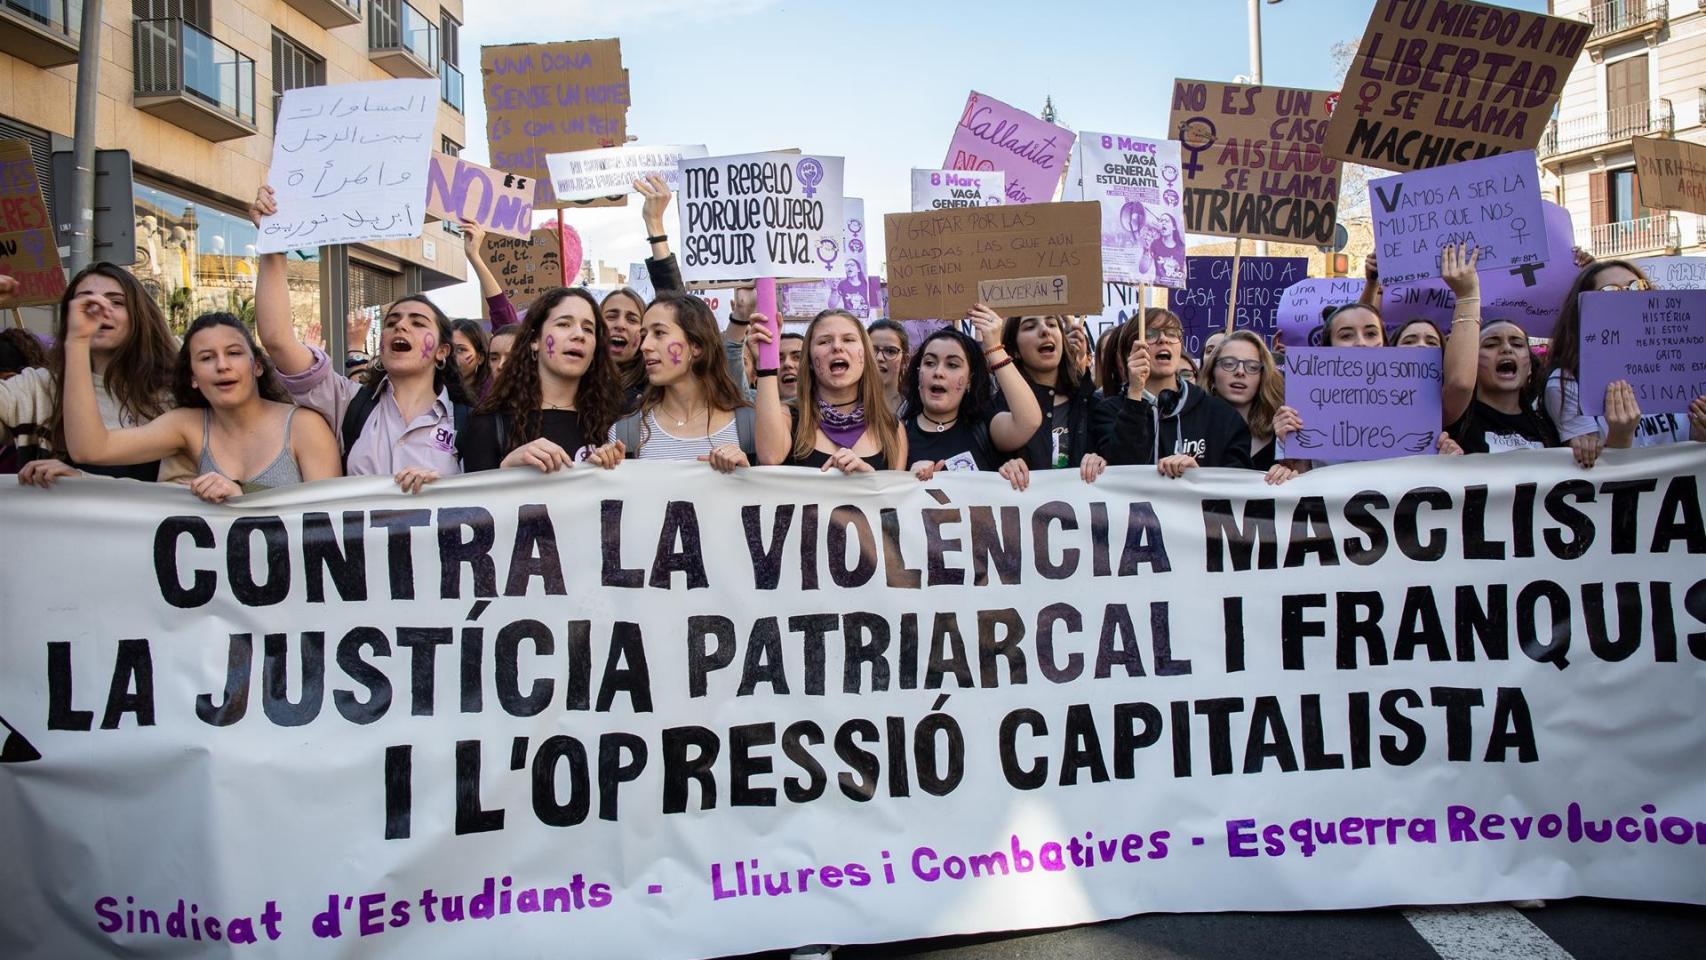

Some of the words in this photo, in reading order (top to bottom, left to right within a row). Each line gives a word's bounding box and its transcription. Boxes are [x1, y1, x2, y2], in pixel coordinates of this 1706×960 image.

[1426, 2, 1520, 46] MIEDO
[1517, 16, 1547, 50] A
[1546, 21, 1595, 59] MI
[1360, 33, 1558, 109] LIBERTAD
[1173, 83, 1207, 112] NO
[1221, 86, 1262, 115] ES
[1275, 89, 1313, 117] UN
[1383, 90, 1425, 121] SE
[1434, 97, 1529, 140] LLAMA
[1269, 117, 1329, 145] CASO
[1101, 135, 1113, 150] 8
[1117, 136, 1157, 156] Març
[1217, 138, 1337, 175] AISLADO
[1345, 118, 1512, 170] MACHISM
[1104, 163, 1158, 179] GENERAL
[1123, 154, 1158, 167] VAGA
[426, 157, 494, 225] NO
[930, 172, 941, 186] 8
[945, 173, 982, 188] Març
[1096, 174, 1159, 189] ESTUDIANTIL
[1221, 168, 1251, 191] SE
[1259, 171, 1338, 201] LLAMA
[1450, 185, 1461, 202] A
[1468, 179, 1496, 200] SER
[1503, 174, 1525, 193] LA
[932, 199, 981, 209] GENERAL
[950, 189, 982, 200] VAGA
[490, 194, 533, 236] NO
[890, 217, 903, 242] Y
[908, 213, 962, 241] GRITAR
[967, 213, 999, 232] POR
[1002, 210, 1036, 229] LAS
[1183, 187, 1337, 243] ATRIARCADO
[1378, 210, 1438, 237] MUJER
[1444, 207, 1473, 226] QUE
[1480, 202, 1514, 223] NOS
[1010, 237, 1041, 251] QUE
[1384, 243, 1403, 258] DE
[1413, 238, 1428, 254] LA
[893, 264, 913, 280] NO
[918, 261, 963, 278] TIENEN
[979, 256, 1018, 273] ALAS
[1036, 250, 1047, 269] Y
[1049, 250, 1081, 268] LAS
[1279, 265, 1297, 282] A
[891, 284, 919, 299] QUE
[924, 282, 942, 297] YA
[946, 280, 965, 296] NO
[981, 282, 1049, 303] VOLVERÁN
[1174, 287, 1217, 307] CASA
[1391, 287, 1420, 304] SIN
[1425, 287, 1457, 309] MIE
[1648, 297, 1661, 309] NI
[1665, 297, 1683, 309] SOY
[1636, 336, 1705, 347] MENSTRUANDO
[1644, 327, 1657, 335] NI
[1662, 325, 1690, 335] ESTOY
[1656, 350, 1682, 361] GRITO
[1287, 355, 1363, 377] Valientes
[1366, 360, 1388, 385] ya
[1625, 363, 1662, 375] PORQUE
[1670, 363, 1686, 373] NOS
[1309, 388, 1388, 411] queremos
[1391, 389, 1417, 406] ser
[153, 503, 568, 609] CONTRA
[600, 499, 710, 591] LA
[741, 488, 1172, 591] VIOLÈNCIA
[1201, 474, 1706, 573] MASCLISTA
[46, 638, 156, 732] LA
[195, 599, 654, 727] JUSTÍCIA
[687, 601, 1193, 699] PATRIARCAL
[1223, 596, 1246, 674] I
[380, 744, 413, 842] I
[454, 694, 965, 836] L'OPRESSIÓ
[999, 686, 1540, 791] CAPITALISTA
[94, 896, 283, 945] Sindicat
[311, 872, 613, 939] d'Estudiants
[711, 857, 872, 901] Lliures
[883, 850, 896, 885] i
[911, 830, 1171, 882] Combatives
[1225, 816, 1437, 858] Esquerra
